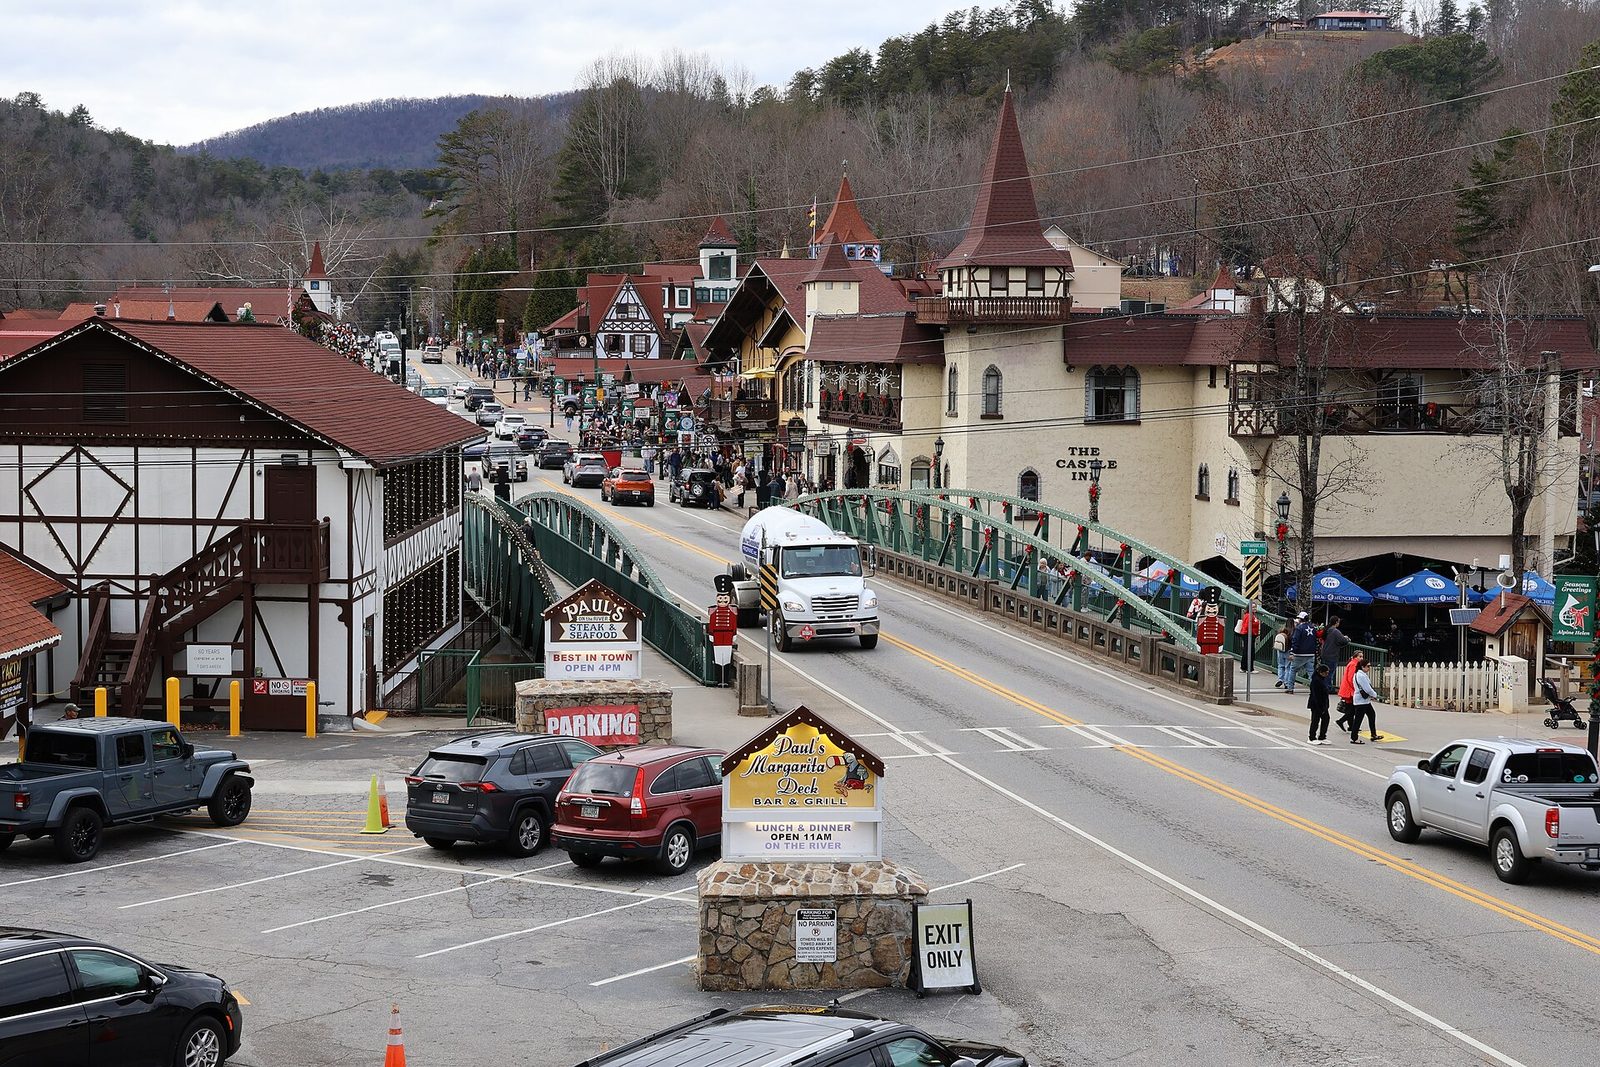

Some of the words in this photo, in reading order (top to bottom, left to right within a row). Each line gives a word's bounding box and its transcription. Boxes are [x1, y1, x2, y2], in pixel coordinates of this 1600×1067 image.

[1068, 447, 1100, 456] THE
[562, 598, 625, 622] PAUL'S
[601, 654, 632, 662] TOWN
[548, 712, 636, 737] PARKING
[773, 736, 826, 756] Paul's
[740, 754, 826, 777] Margarita
[776, 778, 819, 796] Deck
[754, 798, 782, 806] BAR
[788, 798, 798, 806] &
[804, 798, 848, 806] GRILL
[756, 824, 794, 832] LUNCH
[797, 824, 806, 832] &
[810, 824, 852, 832] DINNER
[770, 833, 800, 841] OPEN
[804, 833, 832, 841] 11AM
[764, 842, 782, 850] ON
[785, 842, 806, 850] THE
[809, 842, 842, 850] RIVER
[924, 924, 962, 945] EXIT
[927, 950, 962, 968] ONLY
